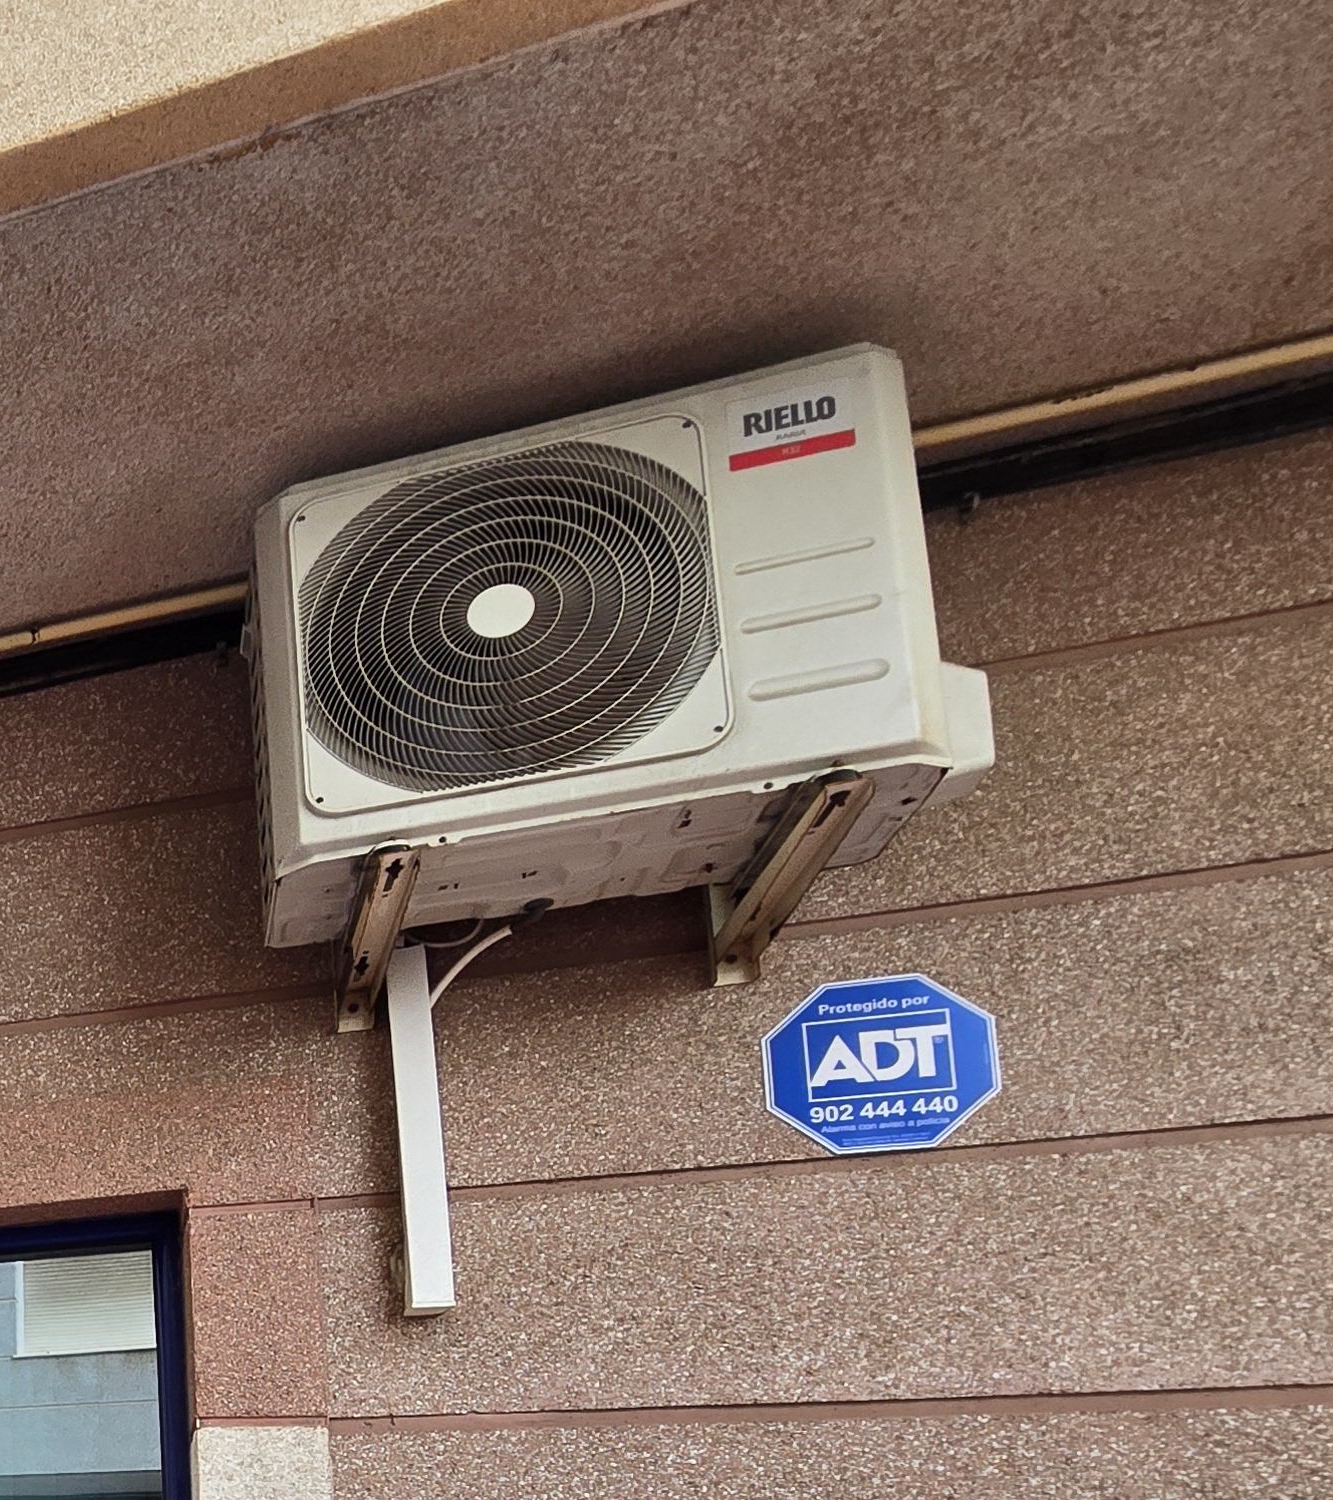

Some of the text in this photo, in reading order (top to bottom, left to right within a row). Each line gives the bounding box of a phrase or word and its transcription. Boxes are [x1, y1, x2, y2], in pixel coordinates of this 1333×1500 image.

[743, 396, 836, 437] RIELLO
[818, 995, 930, 1016] Protegido por
[810, 1023, 951, 1088] ADT
[810, 1095, 958, 1123] 902 444 440
